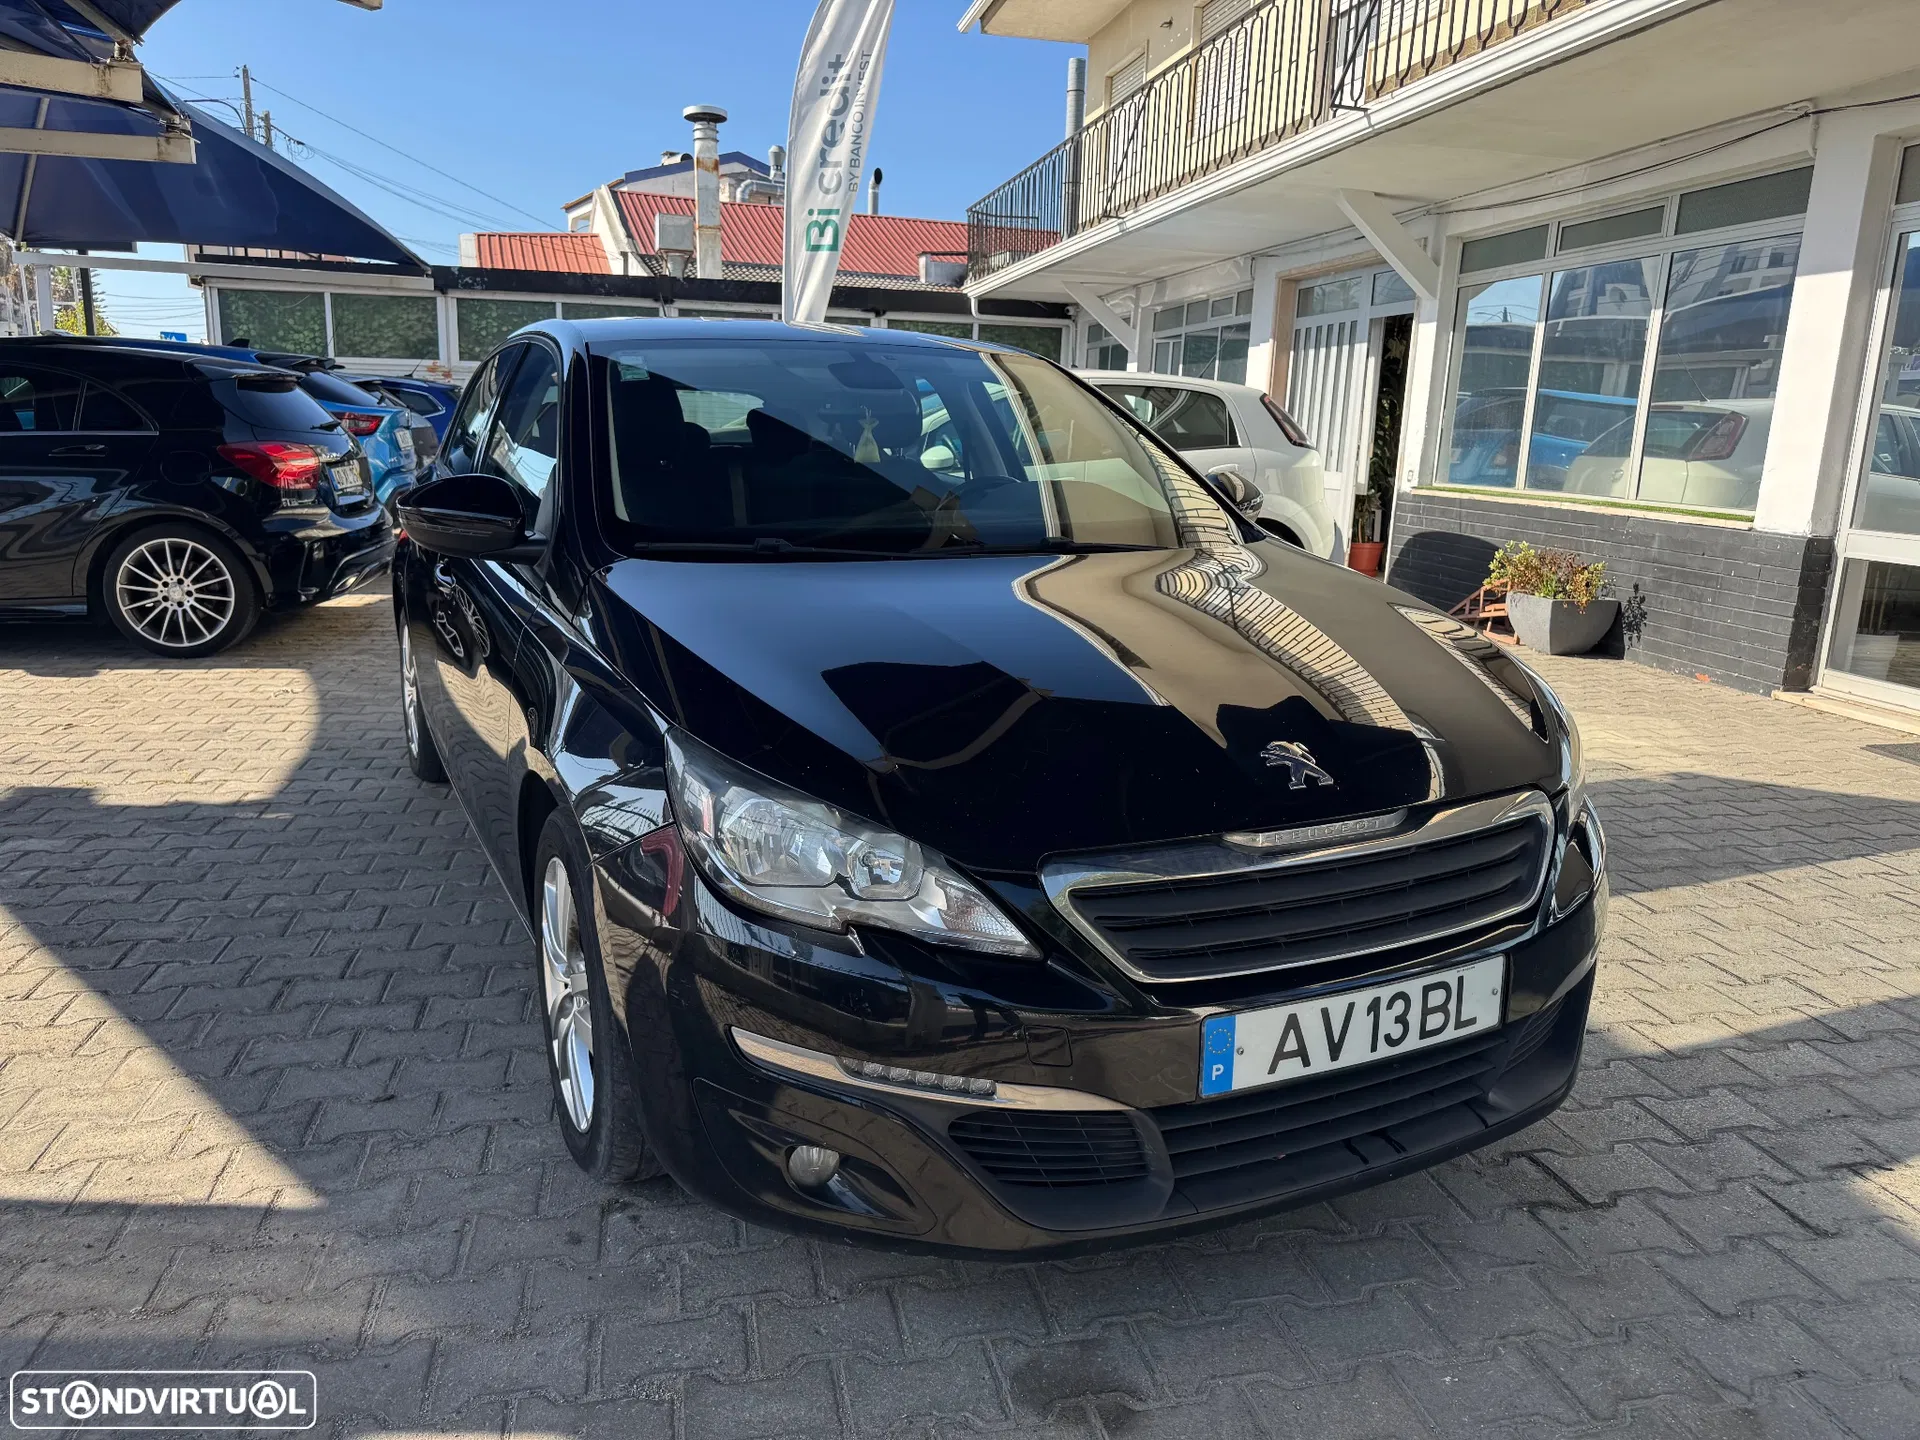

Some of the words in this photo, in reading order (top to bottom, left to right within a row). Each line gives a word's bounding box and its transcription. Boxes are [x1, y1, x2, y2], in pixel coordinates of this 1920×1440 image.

[855, 50, 873, 108] INVEST
[818, 53, 851, 195] credit
[849, 111, 865, 168] BANCO
[848, 172, 860, 192] BY
[806, 208, 839, 252] Bi
[1274, 820, 1381, 843] PEUGEOT
[1211, 1063, 1225, 1081] P
